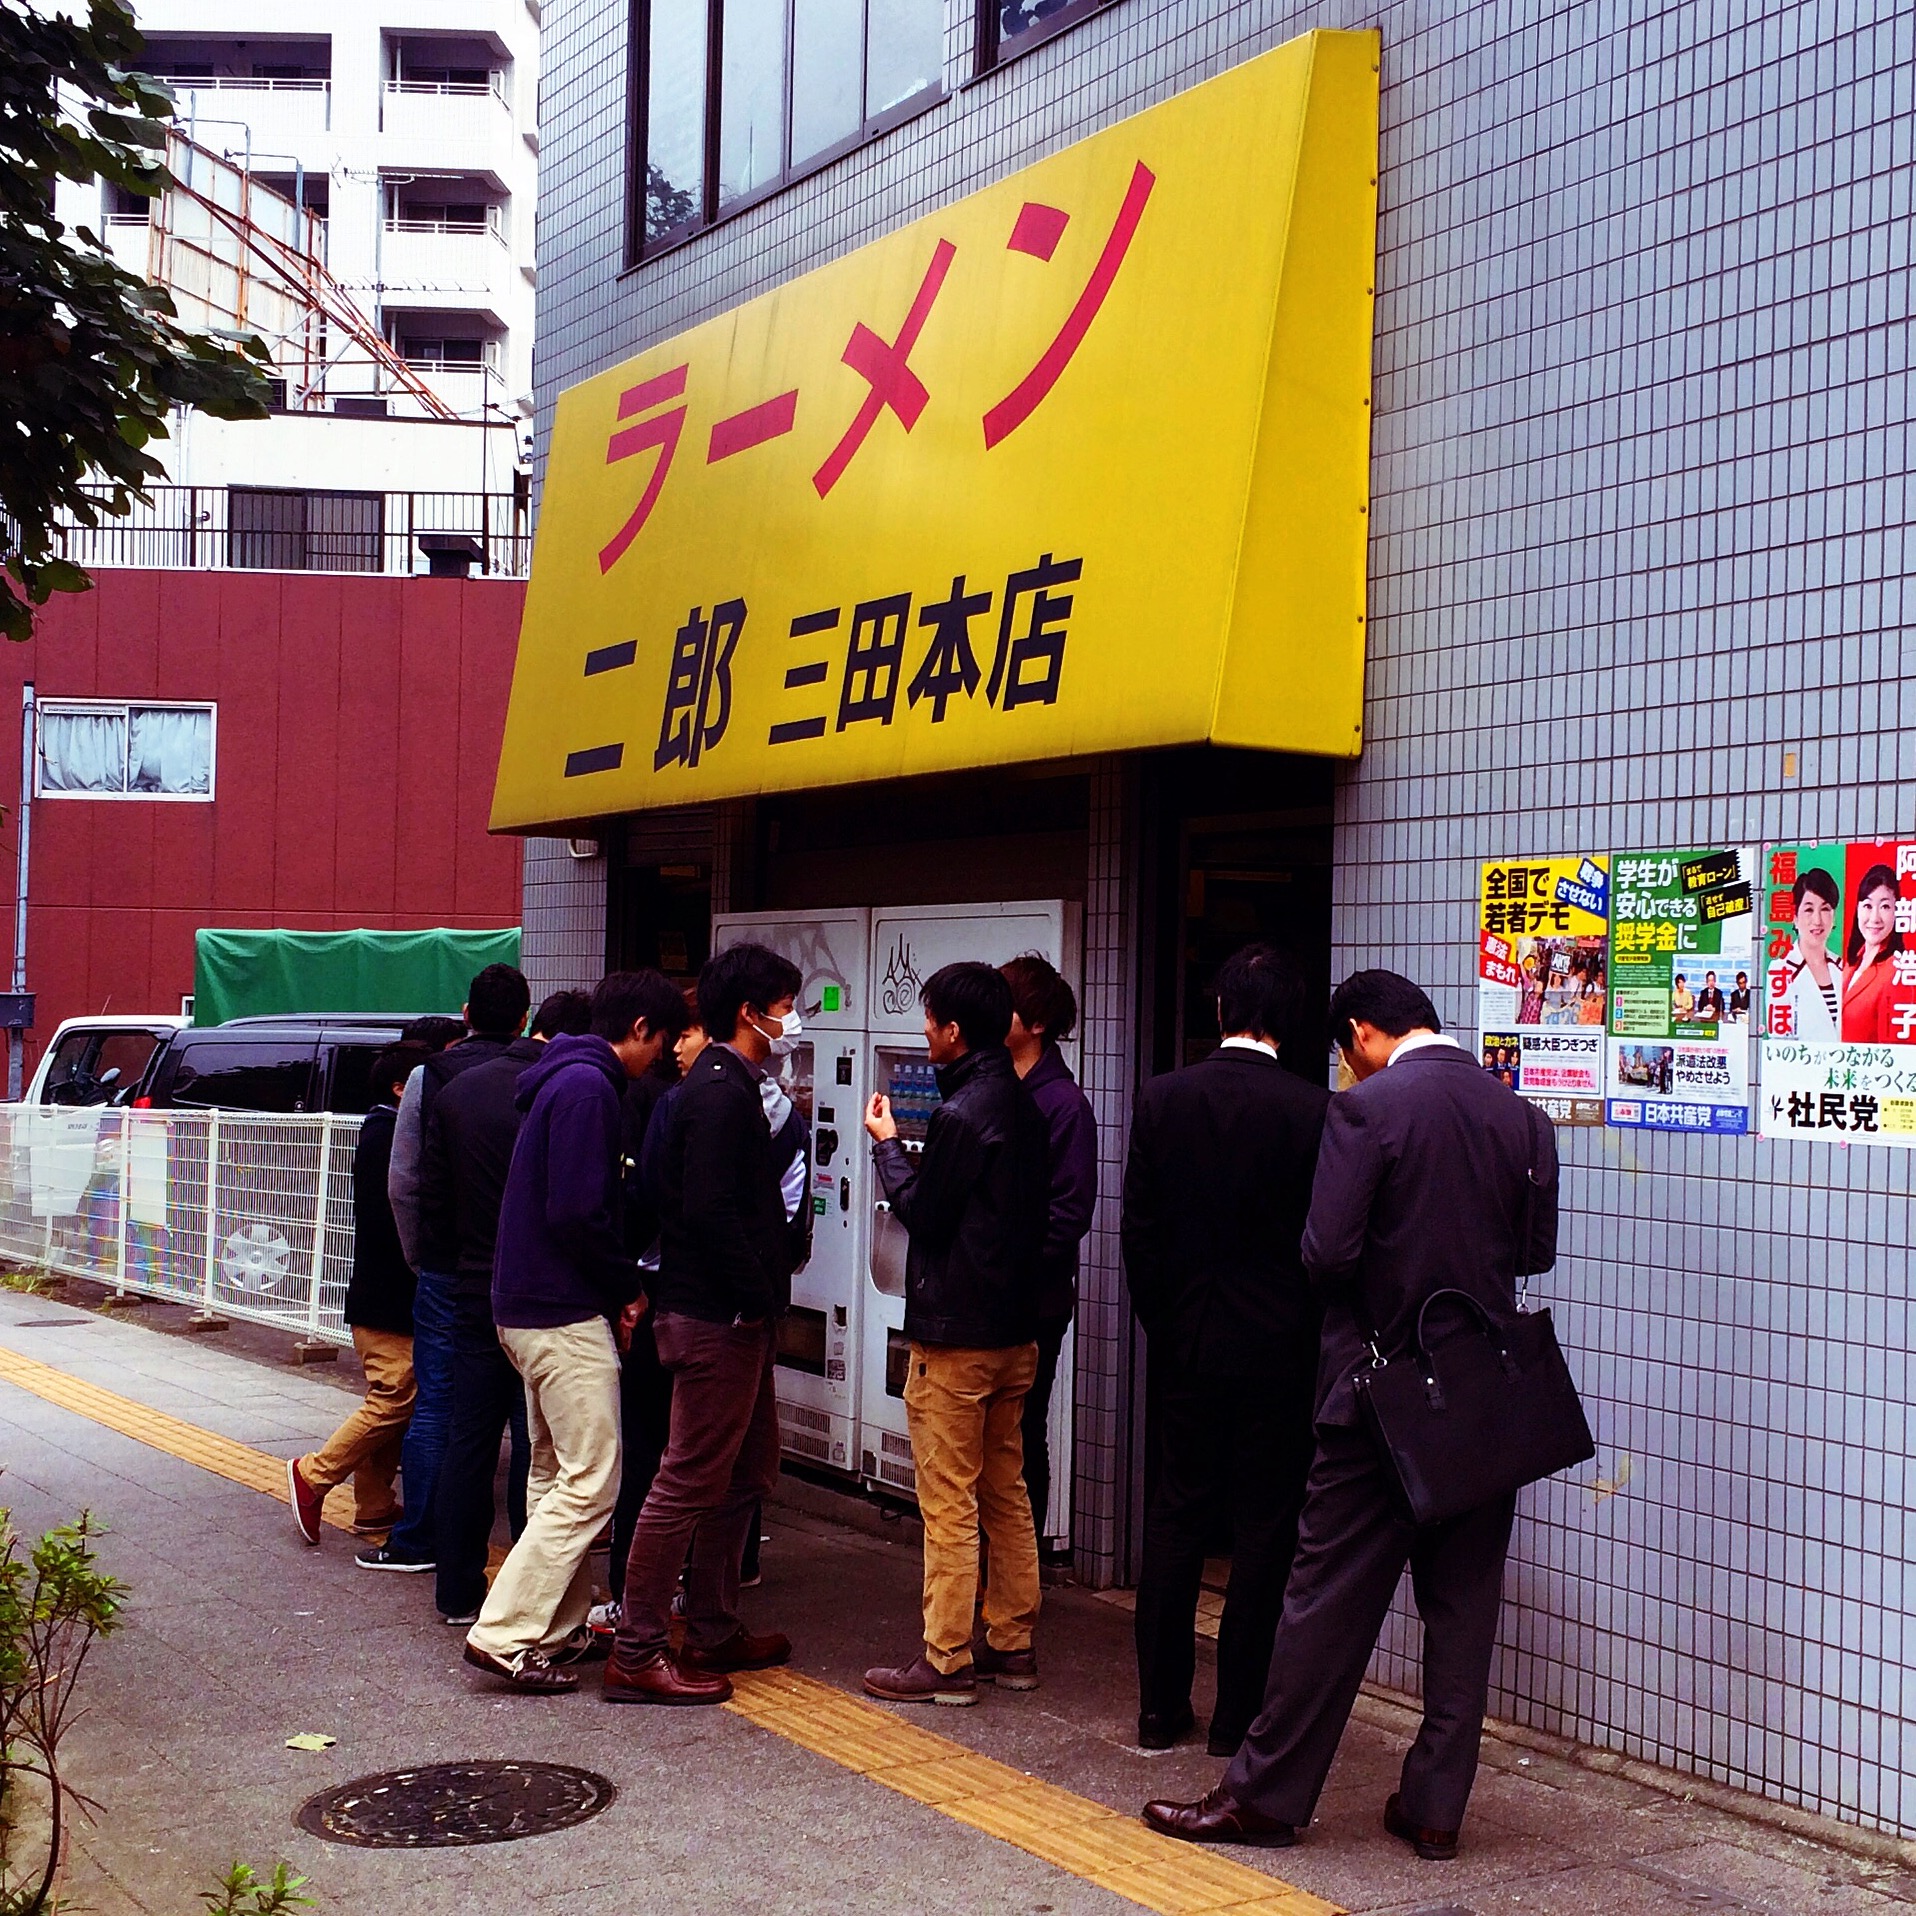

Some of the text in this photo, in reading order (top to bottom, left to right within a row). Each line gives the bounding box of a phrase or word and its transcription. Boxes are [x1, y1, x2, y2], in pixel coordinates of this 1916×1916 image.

[597, 158, 1157, 577] ラーメン
[564, 553, 1085, 779] 二郎 三田本店
[1486, 867, 1551, 899] 全国で
[1616, 858, 1679, 889] 学生が
[1556, 880, 1603, 911] させない
[1616, 891, 1697, 920] 安心できる
[1485, 900, 1570, 934] 若者デモ
[1615, 921, 1697, 951] 奨学金に
[1767, 850, 1798, 1037] 福島みずほ
[1485, 961, 1516, 983] まもれ
[1522, 1036, 1598, 1052] 疑惑大臣つぎつぎ
[1766, 1045, 1894, 1068] いのちがつながる
[1675, 1054, 1727, 1070] 派遣法改悪
[1676, 1070, 1731, 1085] やめさせよう
[1645, 1103, 1711, 1127] 日本共産党
[1787, 1090, 1879, 1132] 社民党
